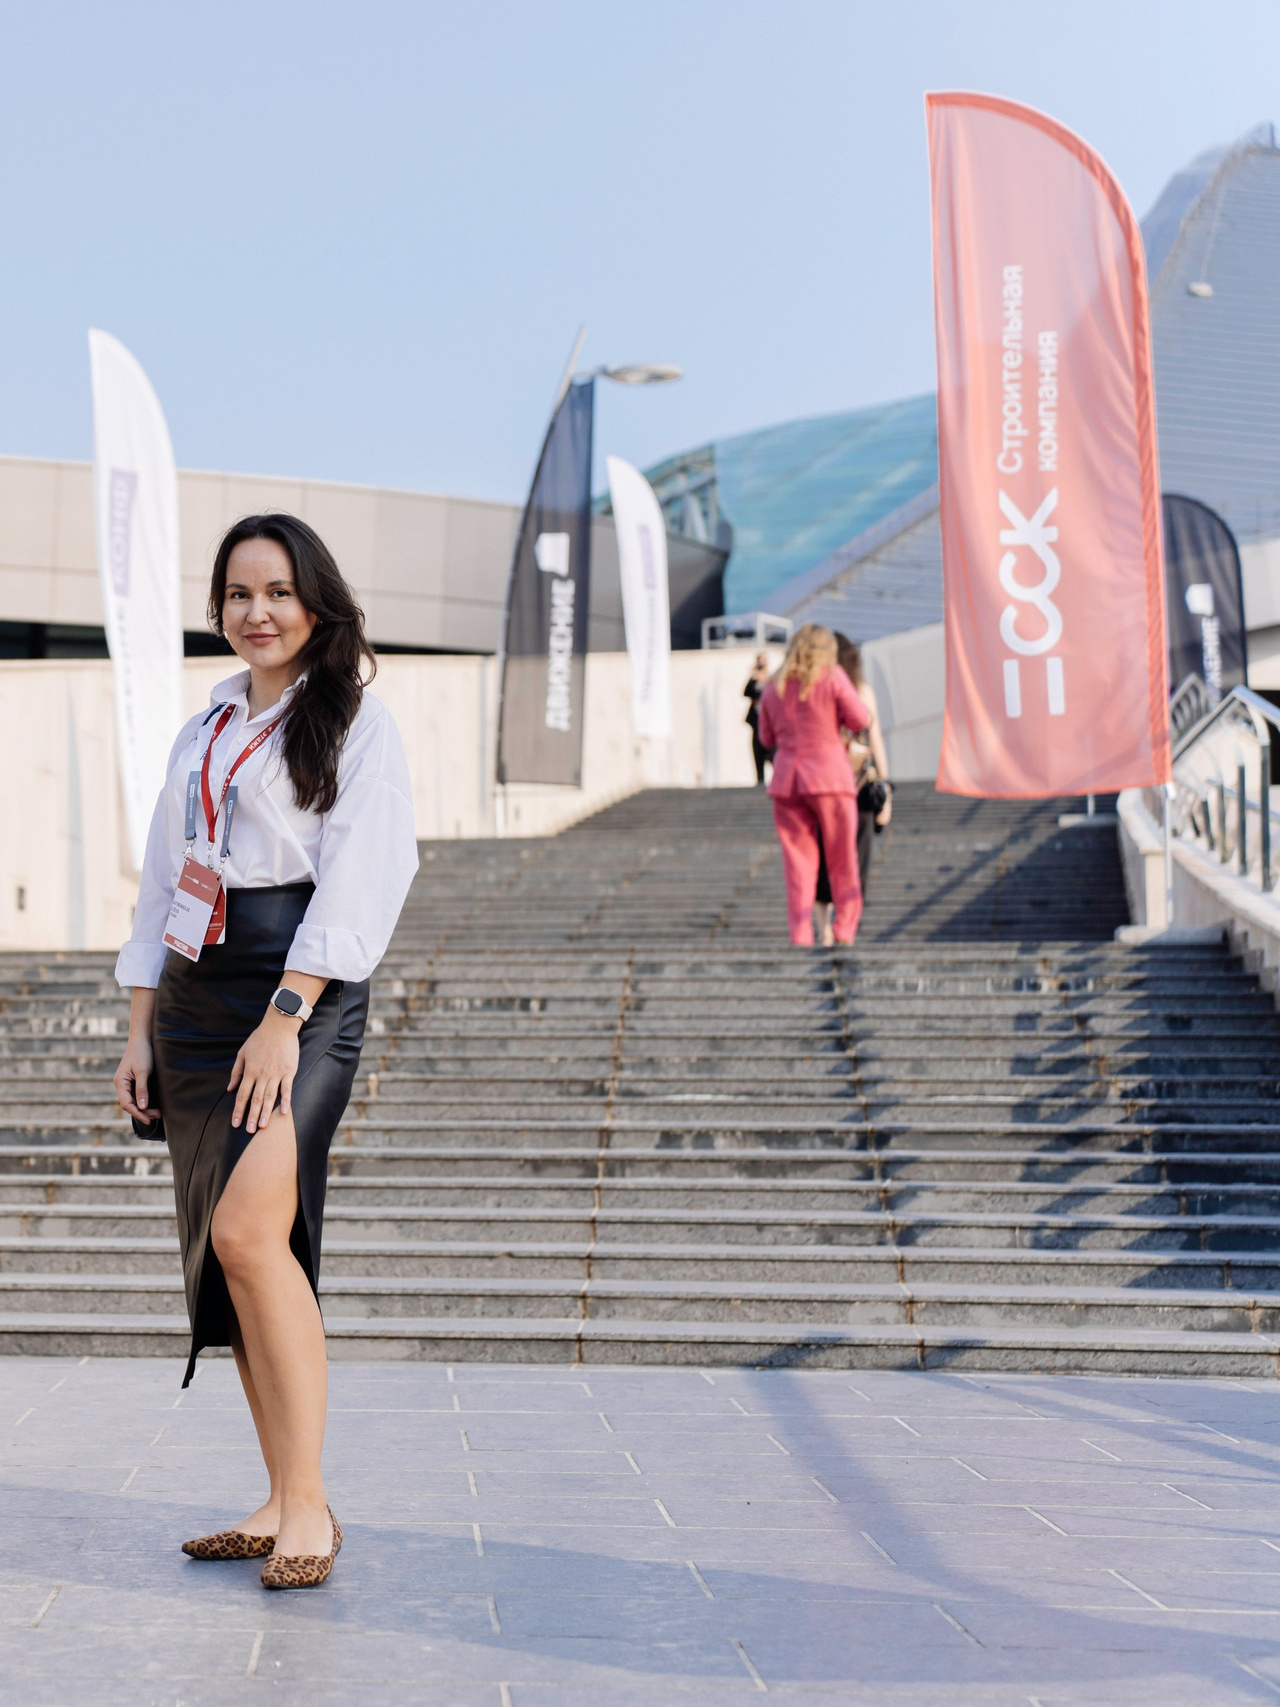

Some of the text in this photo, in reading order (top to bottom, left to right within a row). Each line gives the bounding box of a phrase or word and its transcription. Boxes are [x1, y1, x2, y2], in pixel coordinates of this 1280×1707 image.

[998, 264, 1027, 475] Строительная
[1039, 331, 1060, 473] компания
[546, 578, 576, 732] ДВИЖЕНИЕ
